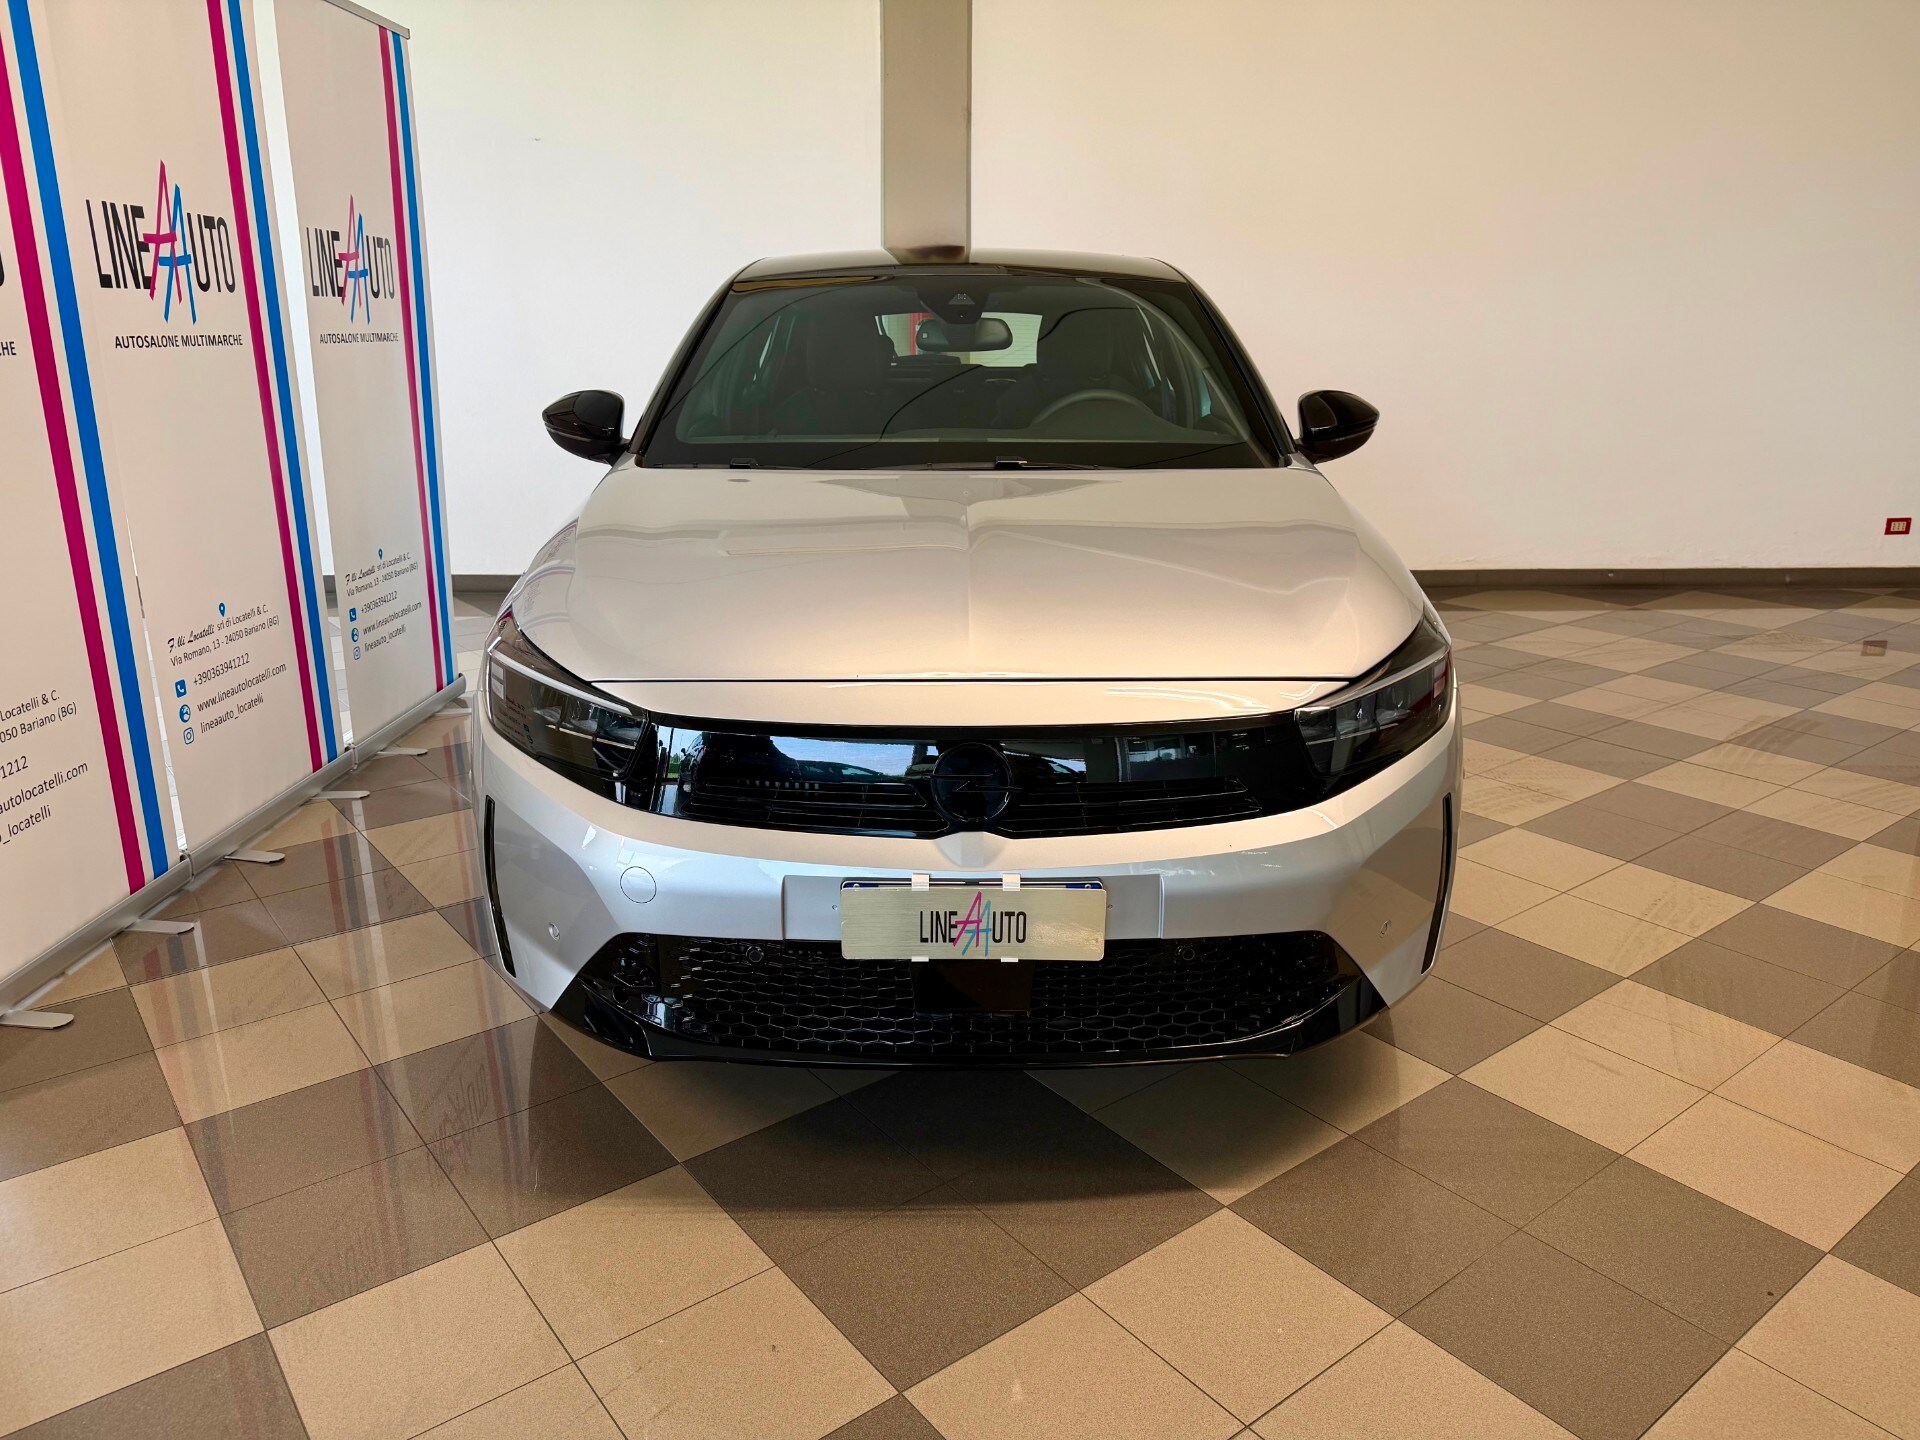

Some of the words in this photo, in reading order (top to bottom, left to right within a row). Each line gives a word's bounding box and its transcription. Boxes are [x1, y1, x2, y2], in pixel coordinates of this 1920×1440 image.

[115, 335, 180, 349] AUTOSALONE
[181, 334, 243, 347] MULTIMARCHE
[319, 333, 360, 344] AUTOSALONE
[360, 333, 399, 342] MULTIMARCHE
[346, 587, 355, 597] Via
[170, 655, 183, 667] Via
[183, 644, 212, 662] Romano,
[212, 638, 221, 650] 13
[224, 629, 244, 645] 24050
[244, 621, 266, 637] Bariano
[266, 614, 280, 630] (BG)
[187, 623, 215, 644] Locatelli
[217, 619, 225, 631] srl
[225, 617, 232, 627] di
[232, 607, 256, 625] Locatelli
[256, 606, 263, 616] &
[262, 604, 269, 614] C.
[193, 652, 251, 686] +390363941212
[197, 663, 287, 712] www.lineautolocatelli.com
[0, 696, 40, 721] Locatelli
[41, 693, 49, 705] &
[50, 689, 60, 701] C.
[20, 713, 56, 735] Bariano
[57, 701, 77, 721] (BG)
[200, 692, 264, 734] lineaauto_locatelli
[0, 755, 29, 779] 1212
[0, 804, 51, 845] _locatelli
